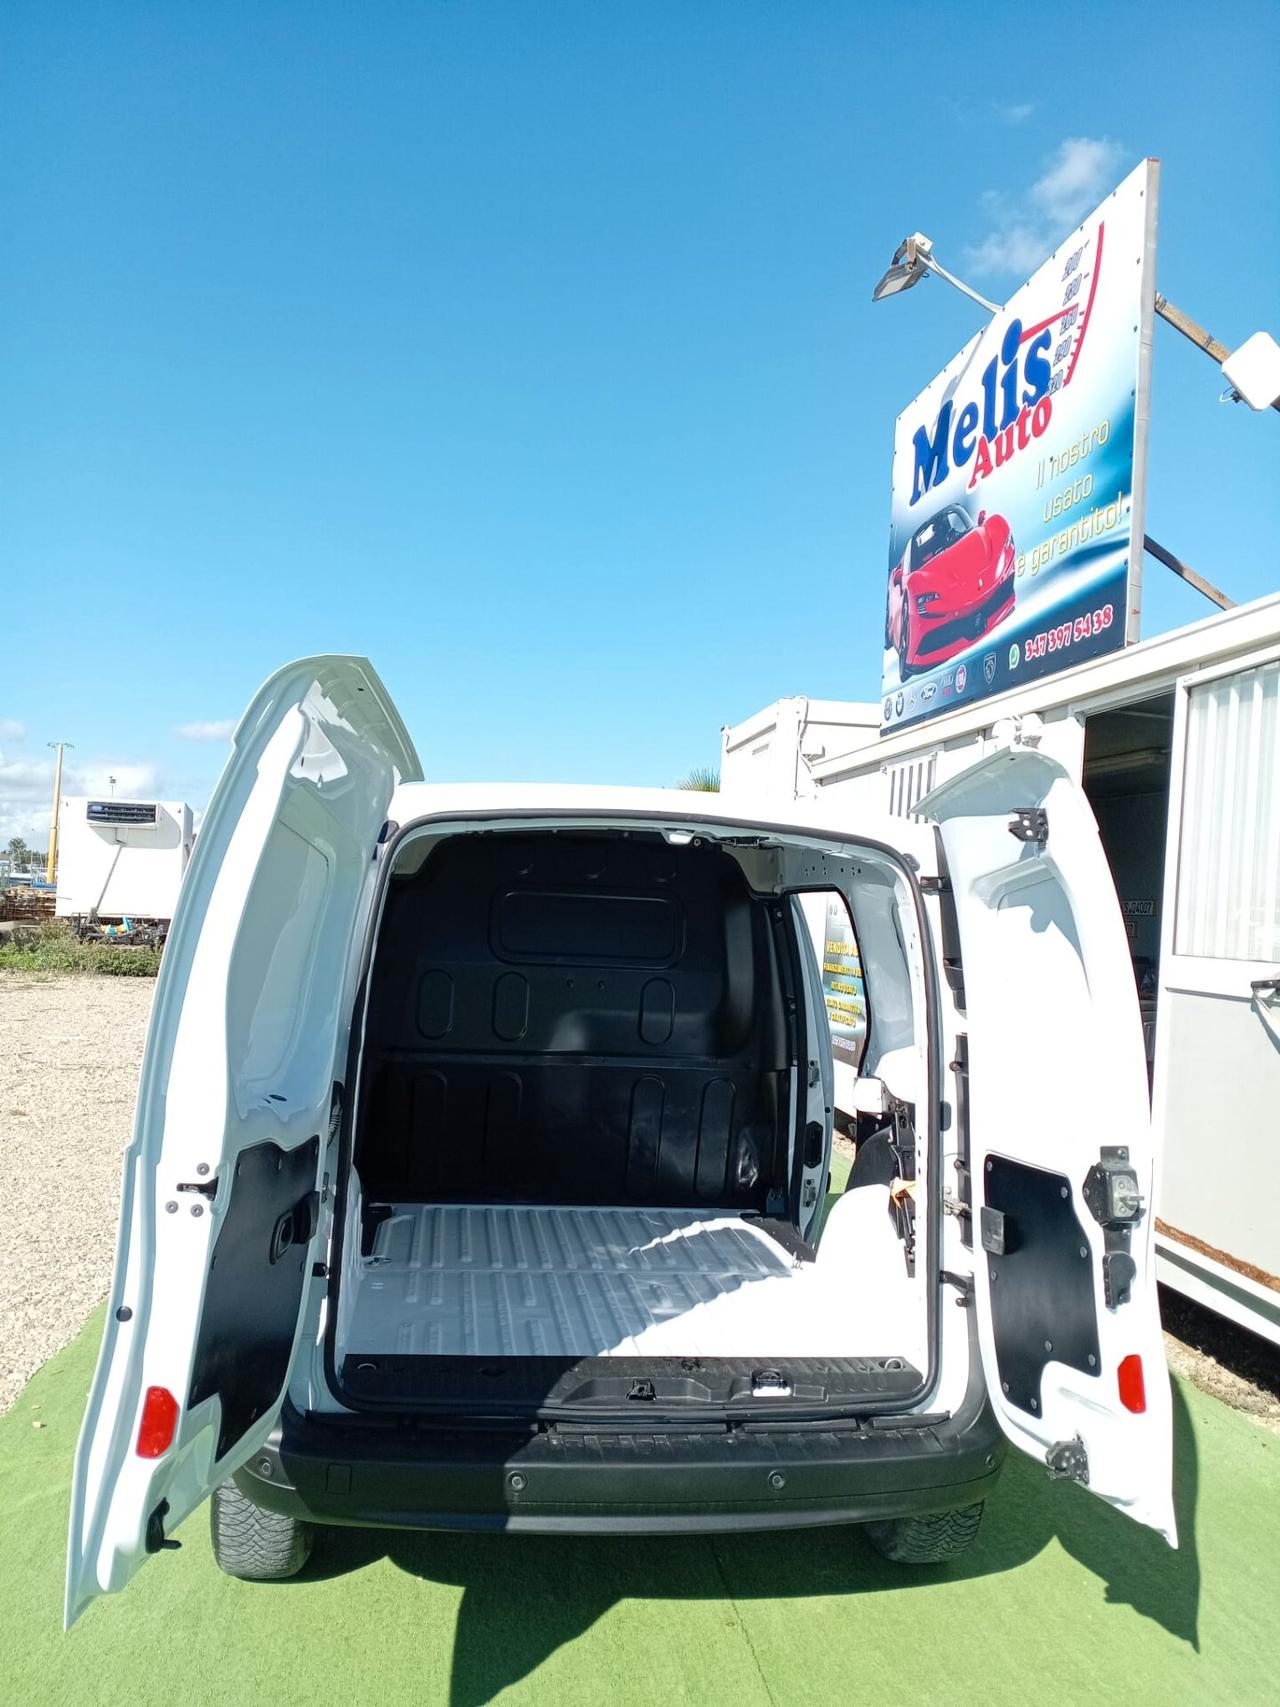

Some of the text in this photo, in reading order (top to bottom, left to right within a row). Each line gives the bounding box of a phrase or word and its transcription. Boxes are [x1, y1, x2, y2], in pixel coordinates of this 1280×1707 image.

[910, 319, 1052, 506] Melis
[968, 396, 1053, 489] Auto
[1050, 419, 1111, 481] nostro
[1015, 491, 1124, 578] è garantito!
[1043, 474, 1094, 524] usato
[1025, 604, 1113, 661] 347 397 54 38
